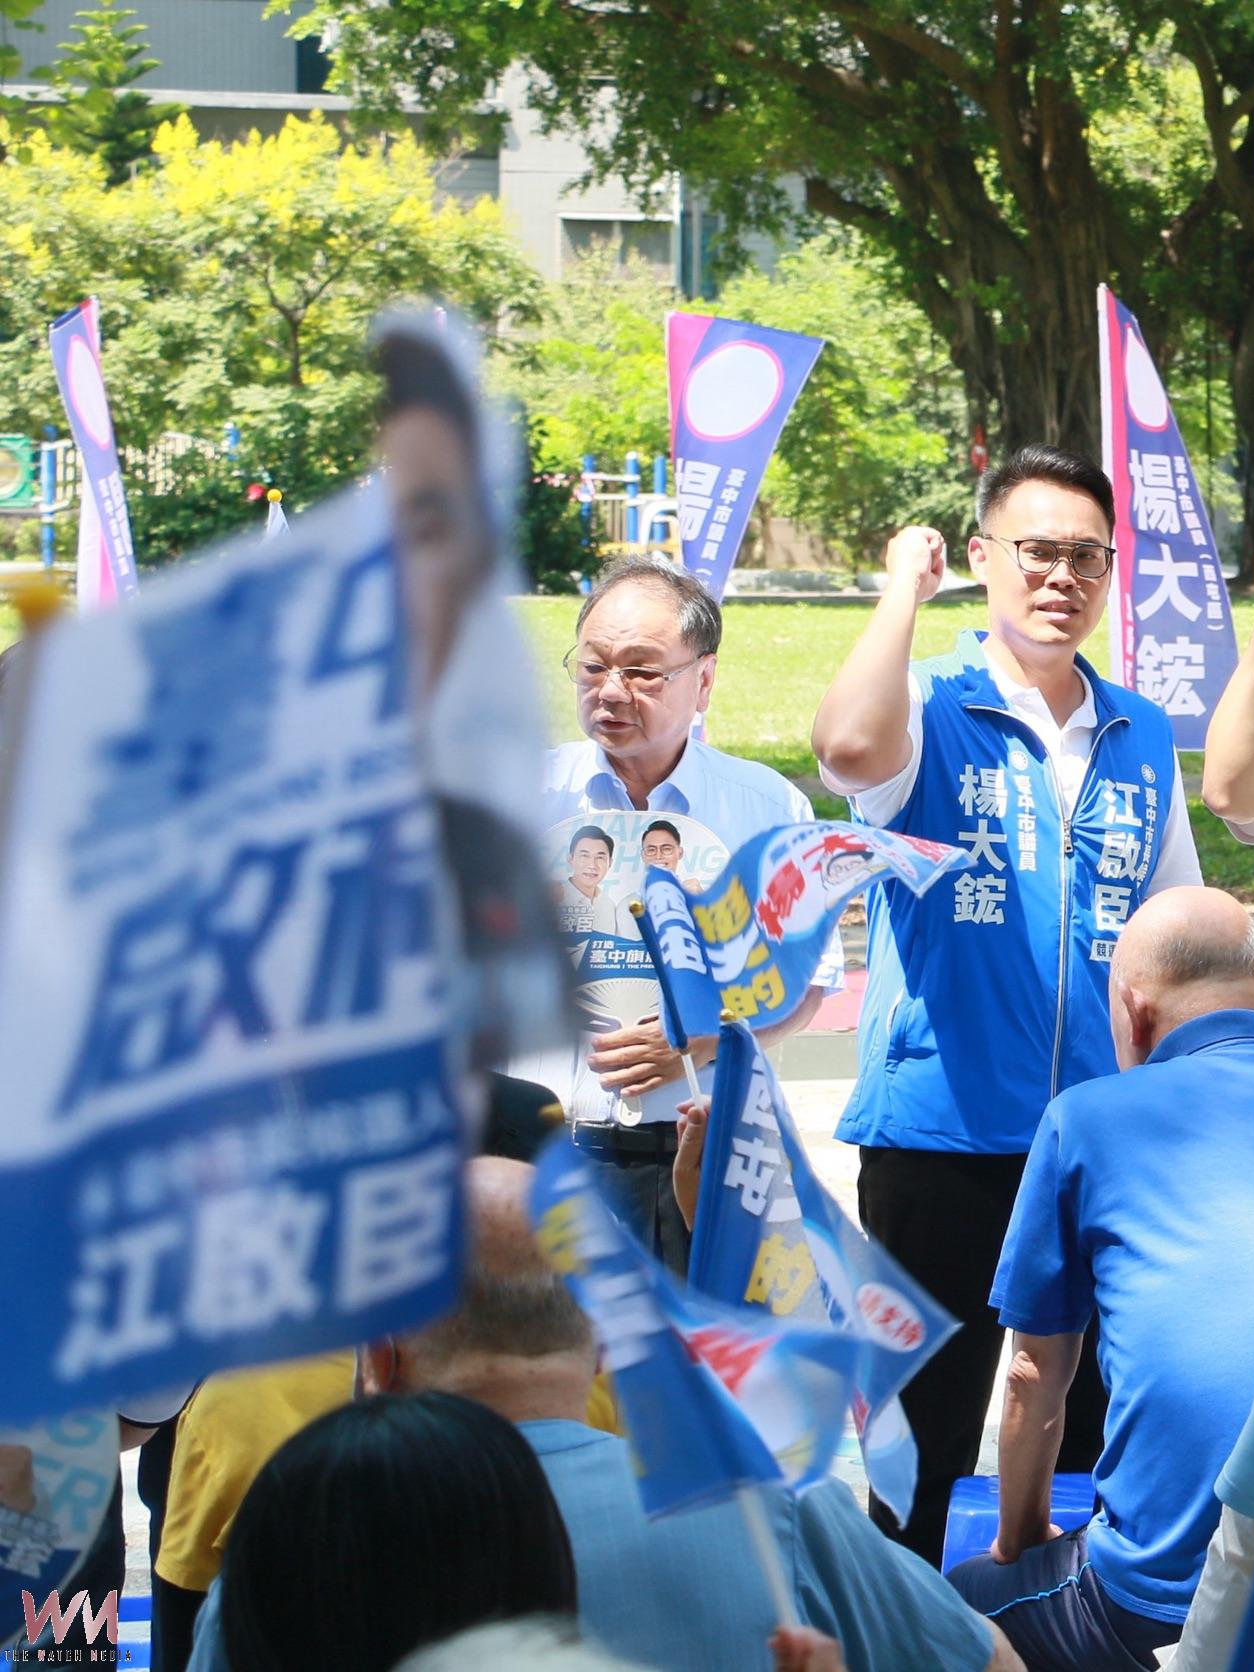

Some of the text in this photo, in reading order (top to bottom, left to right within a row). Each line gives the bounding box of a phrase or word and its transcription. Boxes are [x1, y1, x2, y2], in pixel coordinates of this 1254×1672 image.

[1129, 449, 1206, 717] 楊大鋐
[954, 764, 1008, 925] 楊大鋐
